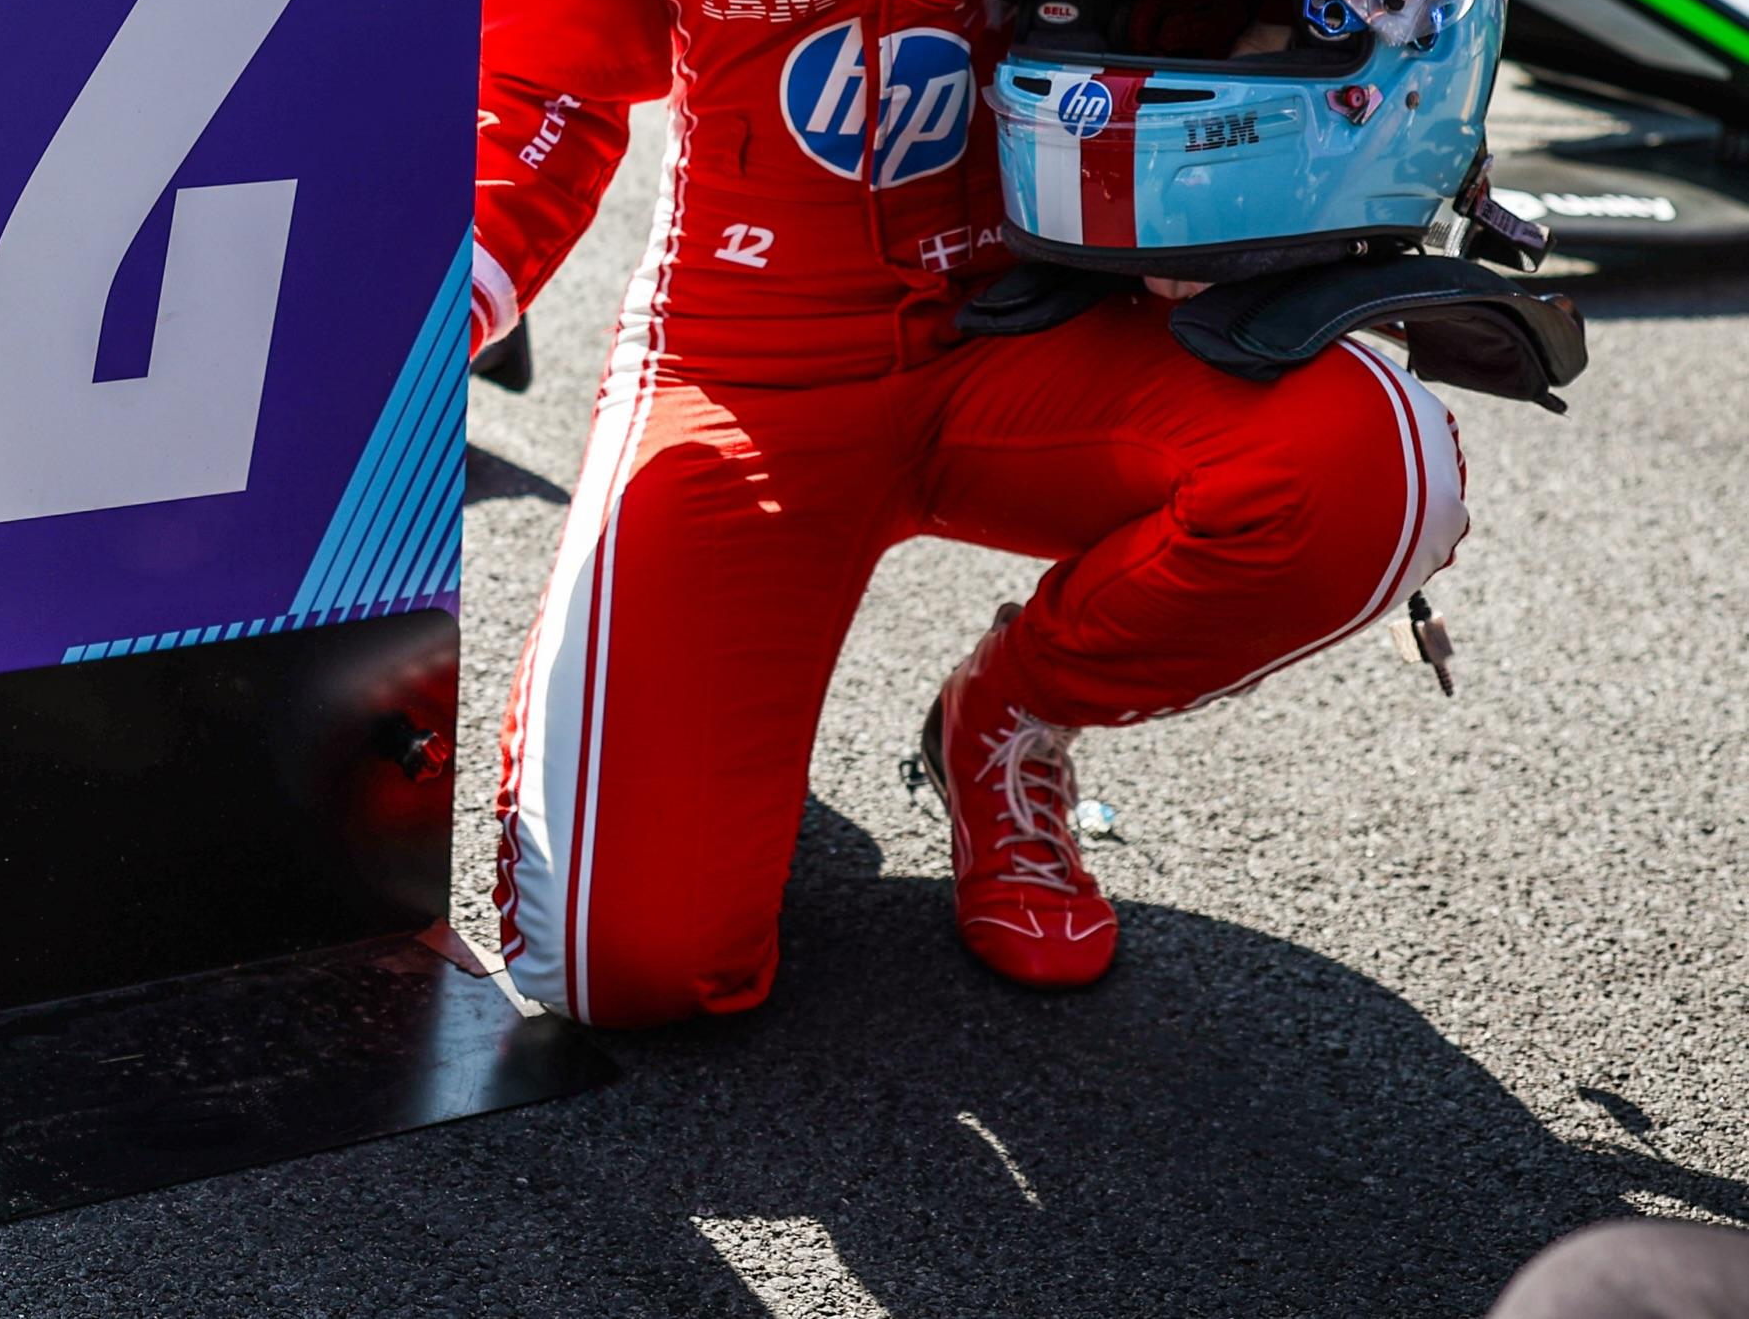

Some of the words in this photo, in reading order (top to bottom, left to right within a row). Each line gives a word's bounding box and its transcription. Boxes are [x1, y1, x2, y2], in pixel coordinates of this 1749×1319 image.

[1043, 6, 1073, 17] BELL
[1062, 80, 1107, 136] hp
[1183, 111, 1260, 152] IBM
[714, 223, 775, 269] 12
